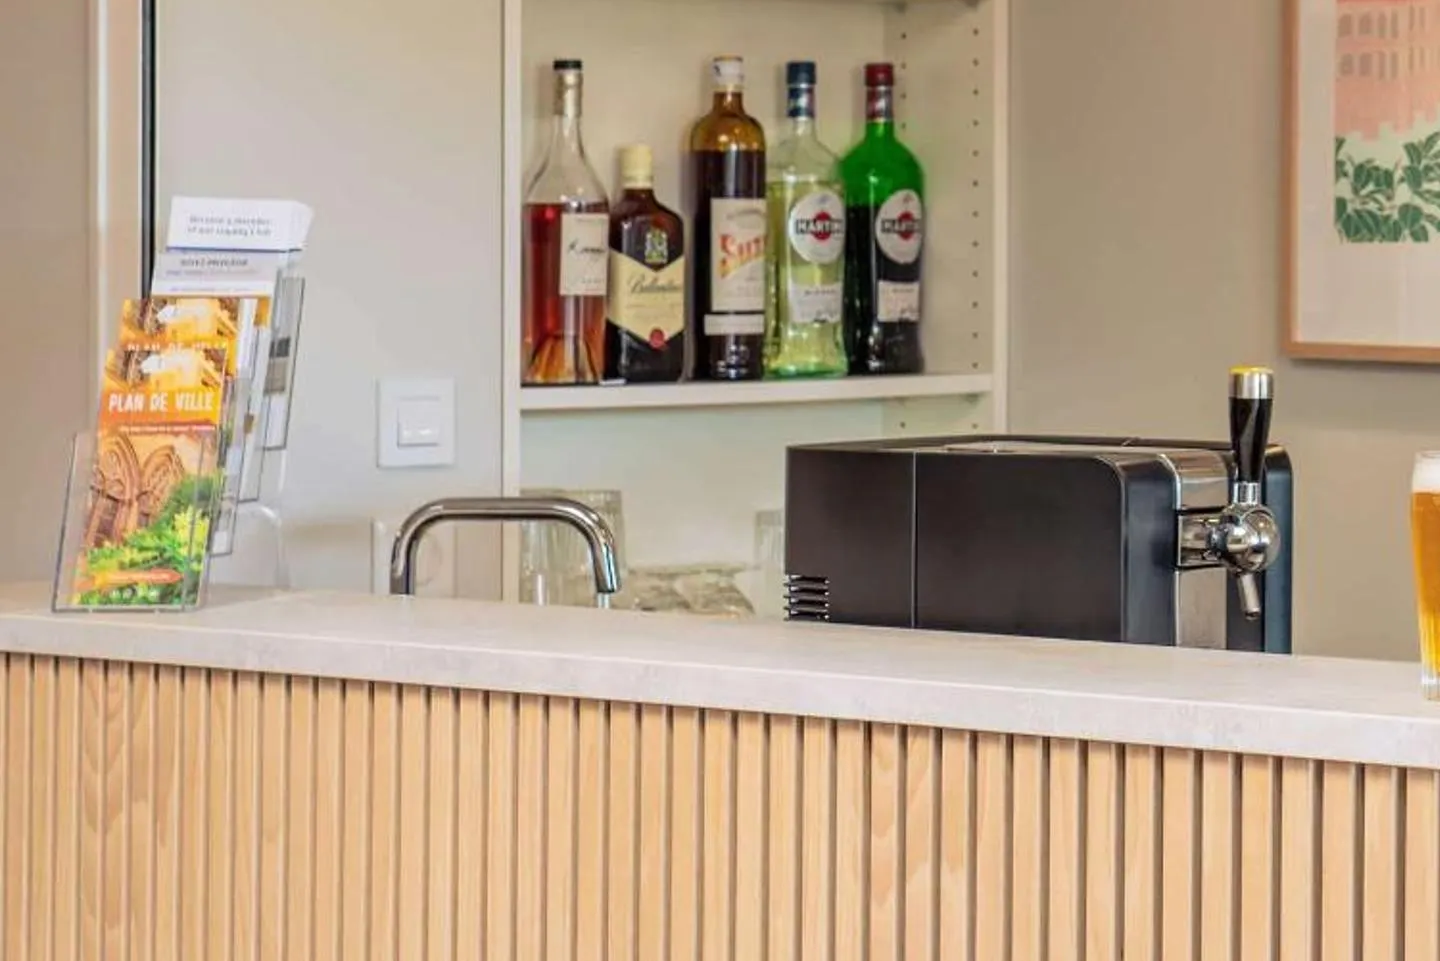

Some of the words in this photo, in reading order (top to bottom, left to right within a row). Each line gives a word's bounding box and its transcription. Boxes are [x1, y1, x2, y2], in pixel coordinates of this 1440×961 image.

[109, 393, 145, 413] PLAN
[150, 393, 168, 413] DE
[175, 392, 214, 412] VILLE
